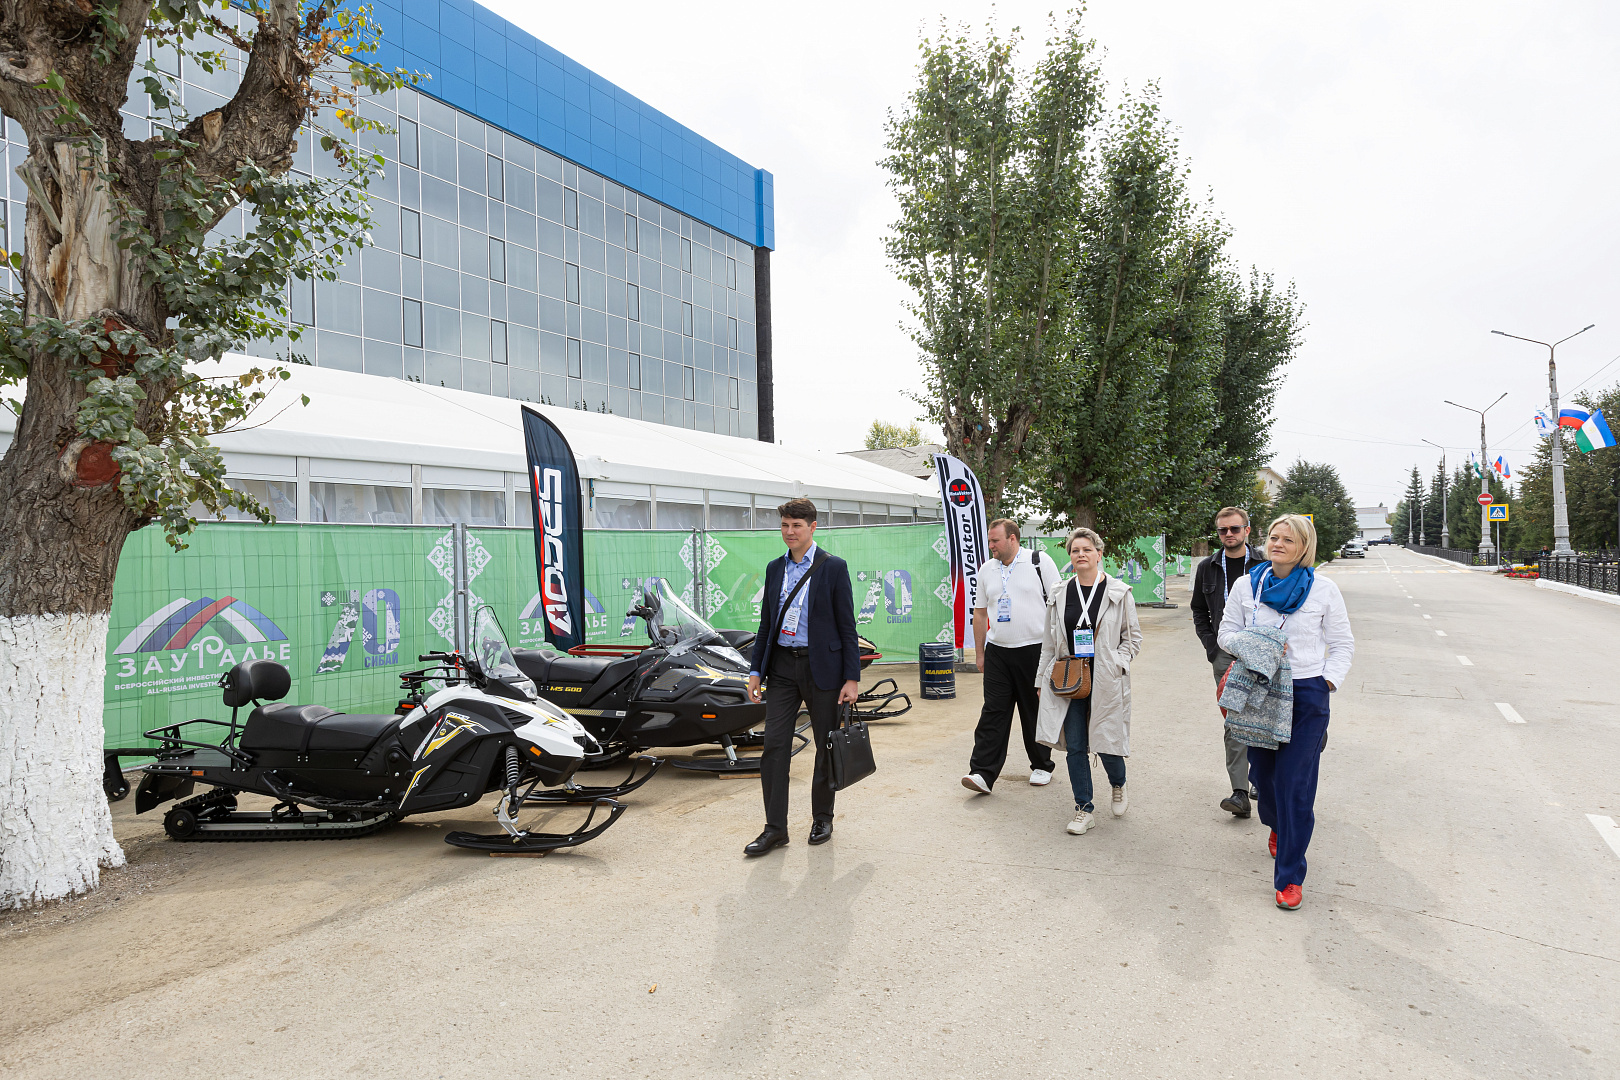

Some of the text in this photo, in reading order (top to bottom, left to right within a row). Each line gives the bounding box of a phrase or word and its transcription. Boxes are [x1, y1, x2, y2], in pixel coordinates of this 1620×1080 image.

[857, 569, 913, 625] 70
[886, 614, 912, 624] СИБАЙ
[316, 588, 400, 674] 70
[364, 651, 399, 668] СИБАЙ
[114, 676, 185, 691] ВСЕРОССИЙСКИЙ
[147, 684, 188, 695] ALL-RUSSIA
